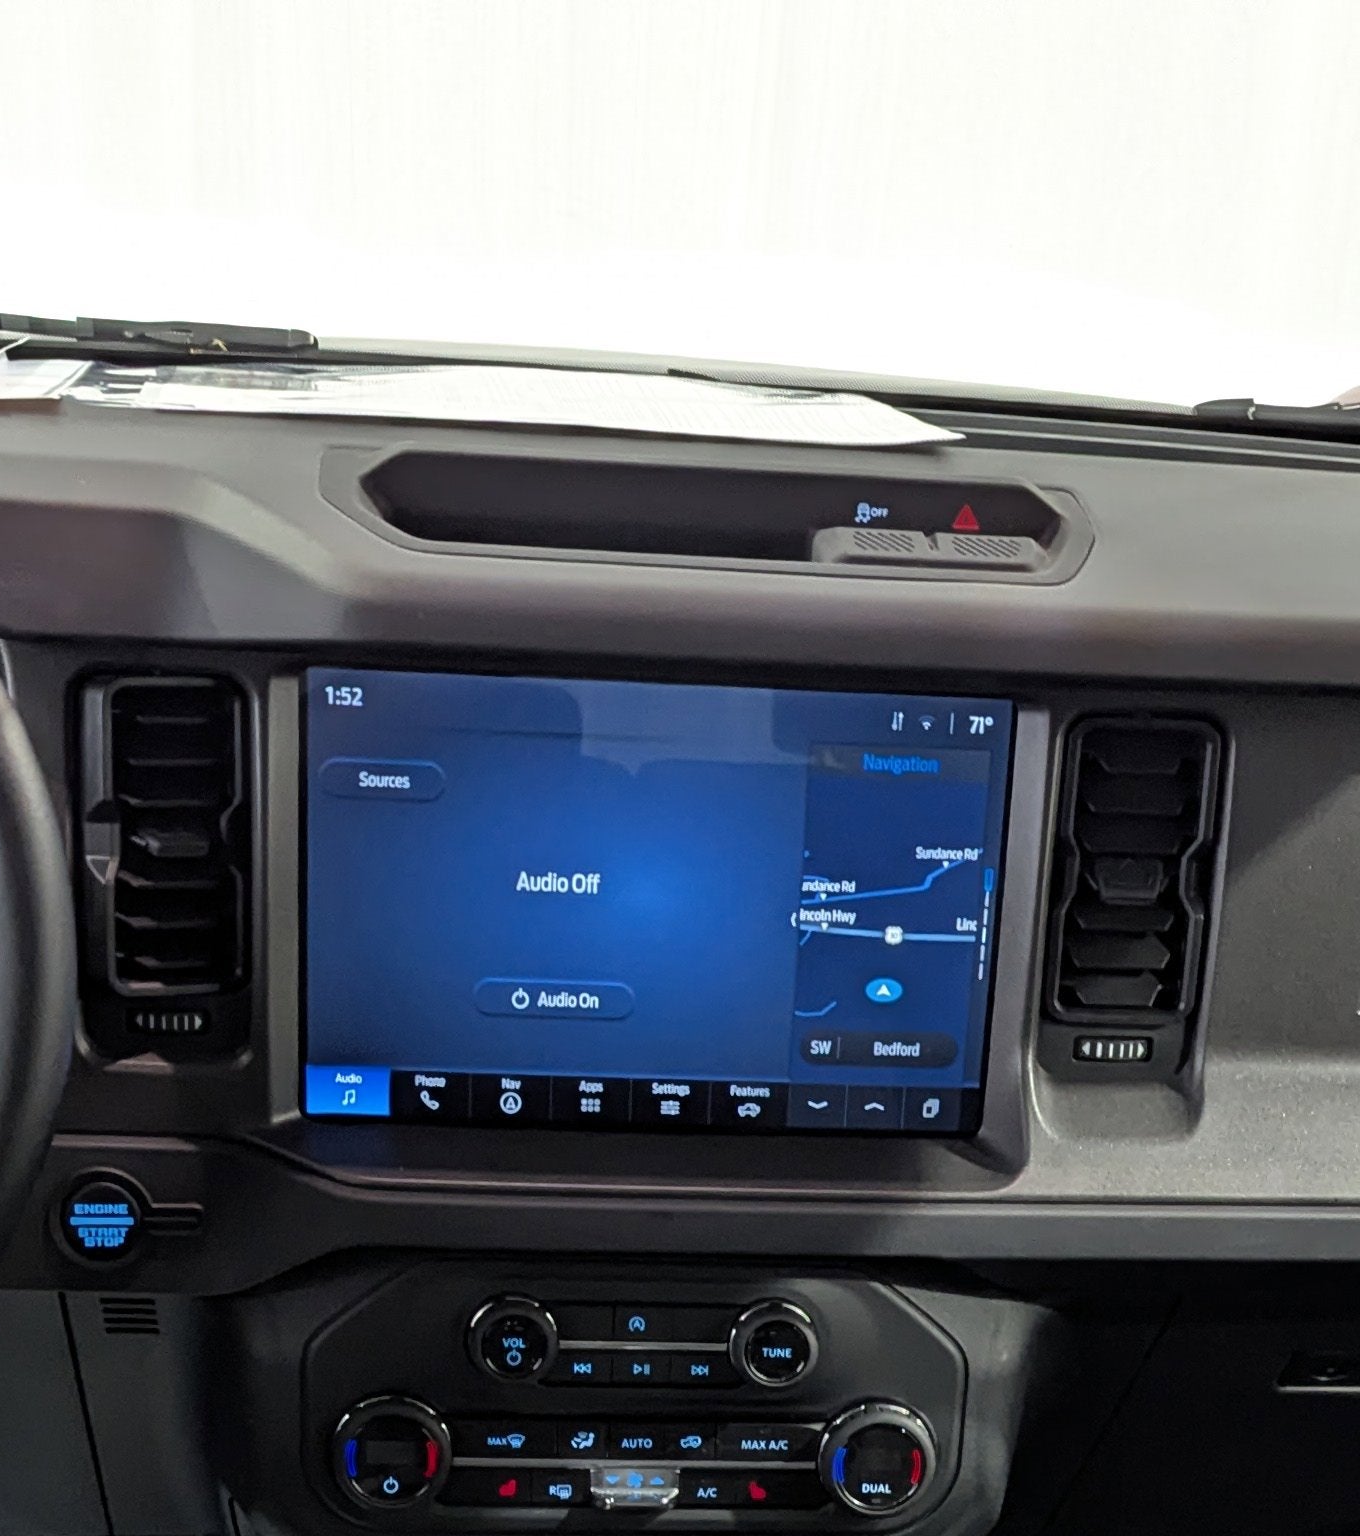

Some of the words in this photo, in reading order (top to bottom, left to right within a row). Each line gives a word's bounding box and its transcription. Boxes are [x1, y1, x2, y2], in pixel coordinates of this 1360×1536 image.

[870, 507, 889, 518] OFF
[325, 686, 363, 706] 1:52
[862, 753, 940, 775] Navigation
[359, 771, 410, 789] Sources
[916, 846, 963, 861] Sundance
[964, 848, 978, 861] Rd
[516, 871, 569, 893] Audio
[572, 873, 600, 895] Off
[842, 880, 856, 893] Rd
[832, 909, 857, 925] Hwy
[538, 991, 577, 1008] Audio
[579, 993, 599, 1009] On
[810, 1041, 832, 1055] SW
[873, 1041, 920, 1057] Bedford
[335, 1073, 362, 1084] Audio
[415, 1075, 446, 1088] Phone
[501, 1078, 521, 1090] Nav
[579, 1080, 603, 1094] Apps
[652, 1083, 690, 1097] Settings
[730, 1084, 770, 1098] Features
[73, 1203, 128, 1215] ENGINE
[78, 1227, 128, 1238] START
[84, 1237, 125, 1248] STOP
[502, 1338, 526, 1349] VOL
[762, 1348, 792, 1359] TUNE
[487, 1436, 507, 1446] MAX
[621, 1438, 653, 1449] AUTO
[741, 1439, 767, 1450] MAX
[768, 1440, 788, 1451] A/C
[697, 1487, 717, 1498] A/C
[861, 1483, 891, 1495] DUAL
